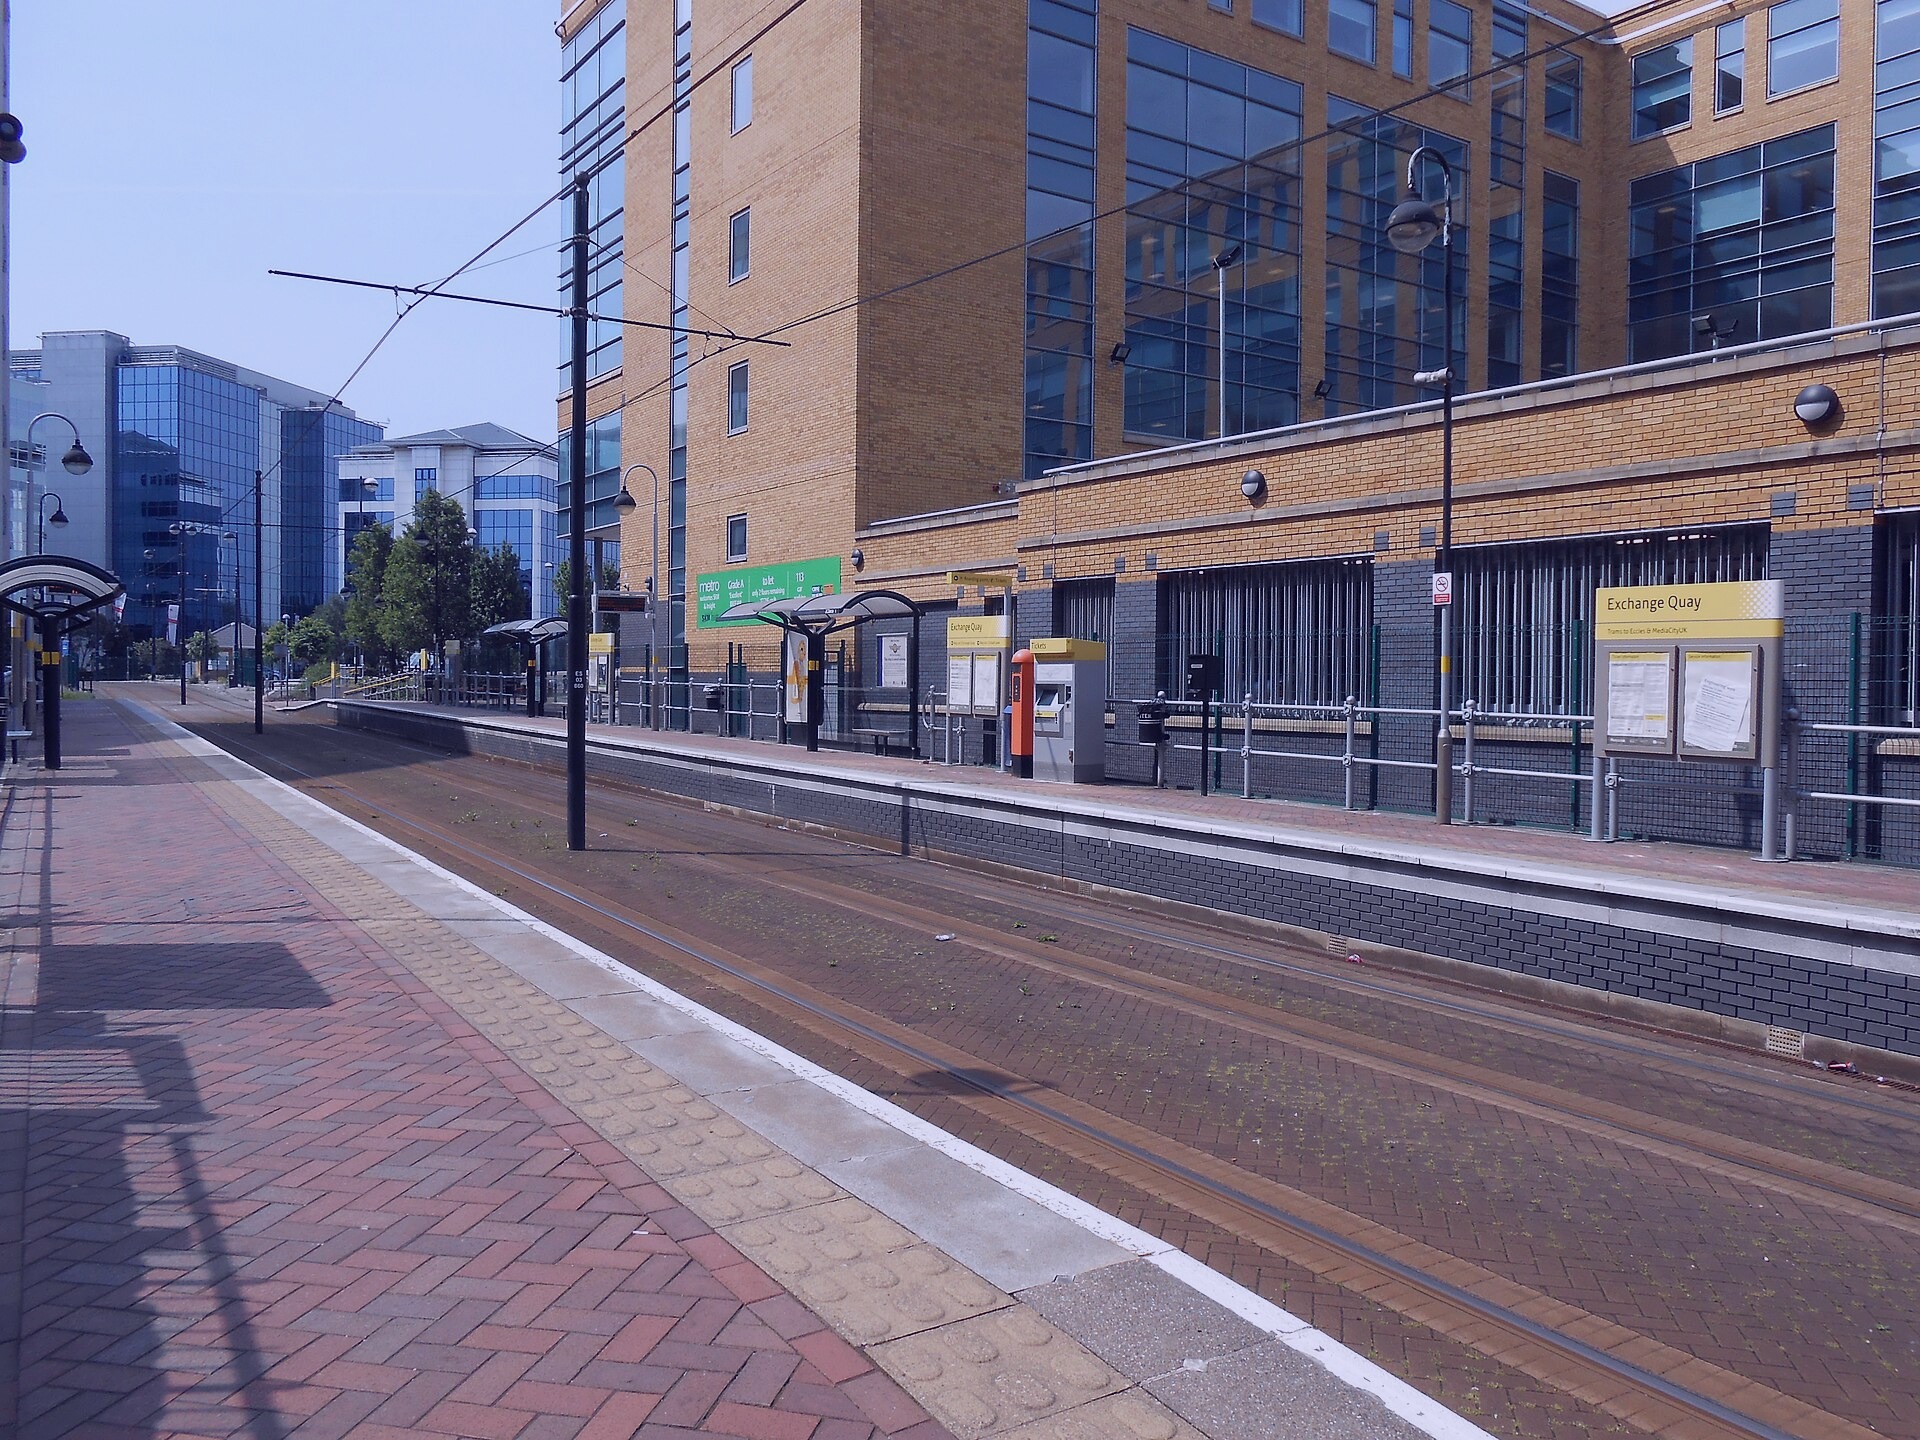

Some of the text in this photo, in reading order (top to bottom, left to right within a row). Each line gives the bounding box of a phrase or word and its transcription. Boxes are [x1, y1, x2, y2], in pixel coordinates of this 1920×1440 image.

[699, 580, 720, 593] metro
[1607, 595, 1702, 613] Exchange Quay
[950, 622, 983, 633] Exchange Quay
[1652, 627, 1688, 635] MediaCityUK
[1031, 642, 1047, 650] Tickets
